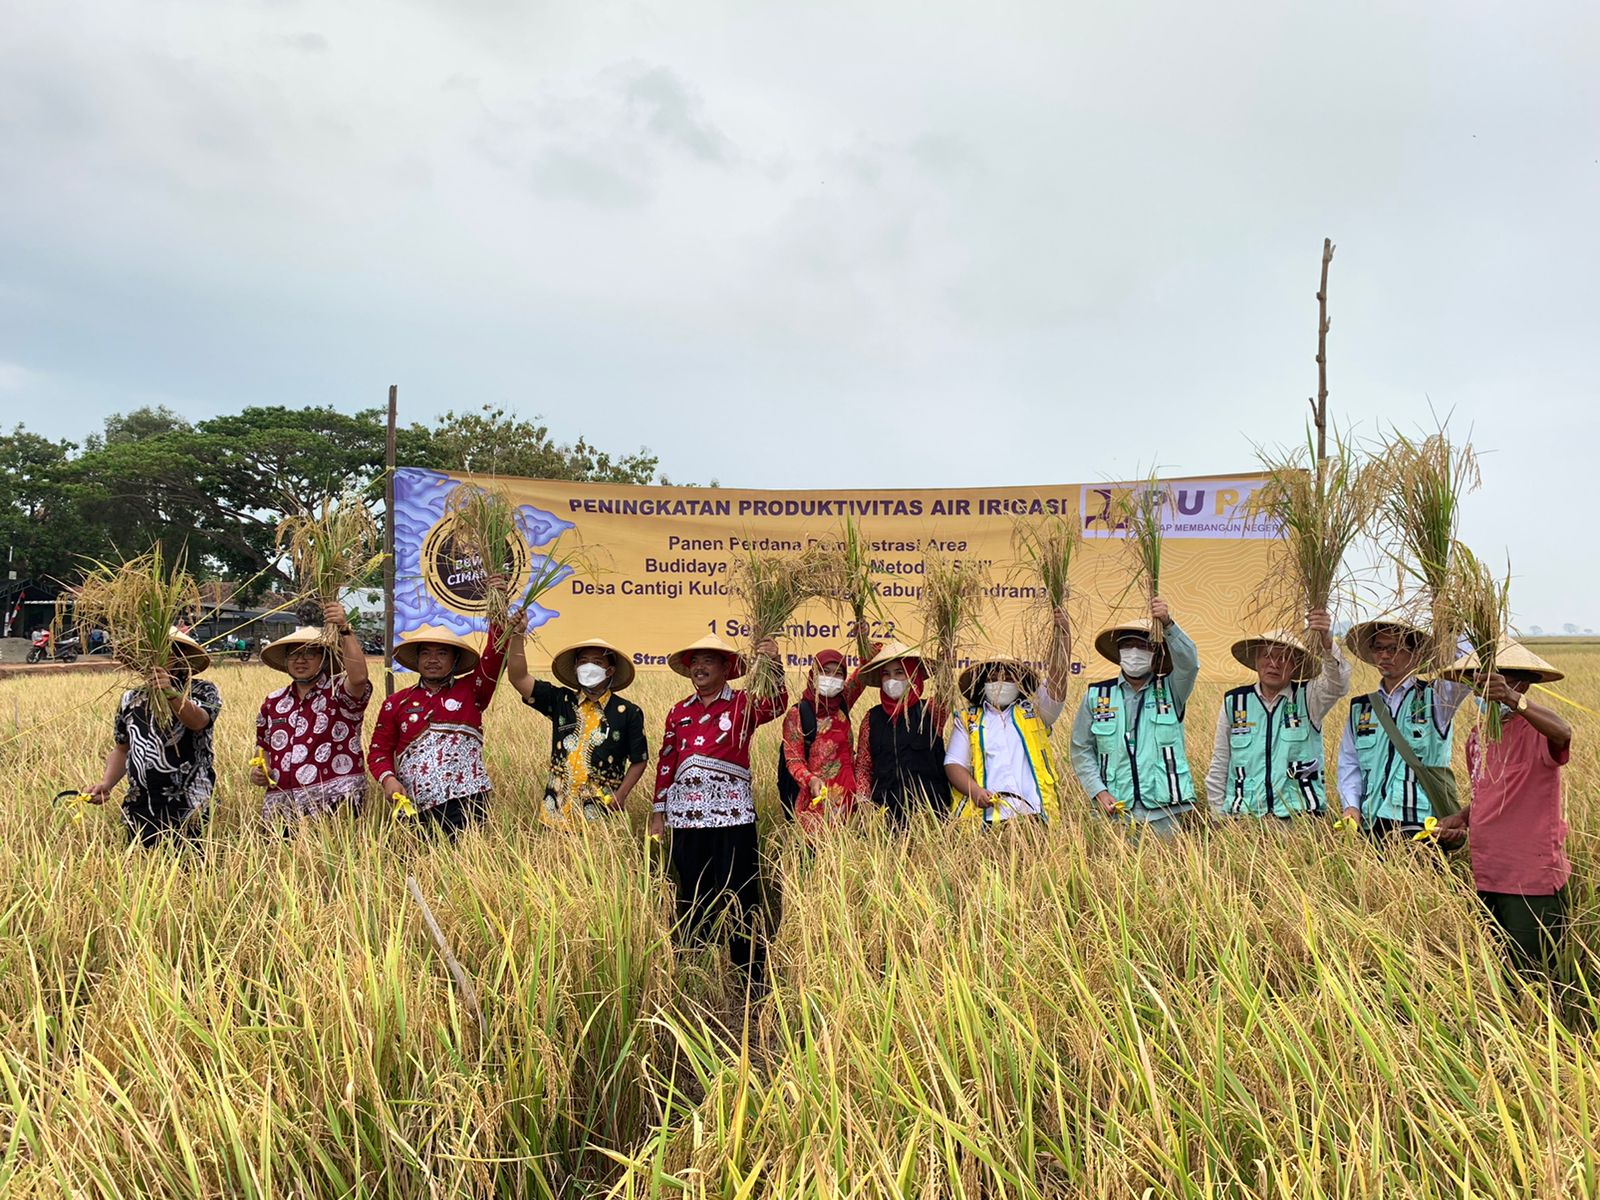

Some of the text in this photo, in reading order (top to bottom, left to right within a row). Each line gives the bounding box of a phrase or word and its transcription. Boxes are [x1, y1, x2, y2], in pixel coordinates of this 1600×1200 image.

[569, 499, 1068, 516] PENINGKATAN PRODUKTIVITAS AIR IRIGASI
[1174, 523, 1242, 533] MEMBANGUN
[669, 536, 723, 550] Panen
[730, 537, 802, 551] Perdana
[928, 539, 968, 552] Area
[646, 558, 727, 576] Budidaya
[572, 581, 615, 595] Desa
[621, 580, 683, 599] Cantigi
[708, 619, 717, 634] 1
